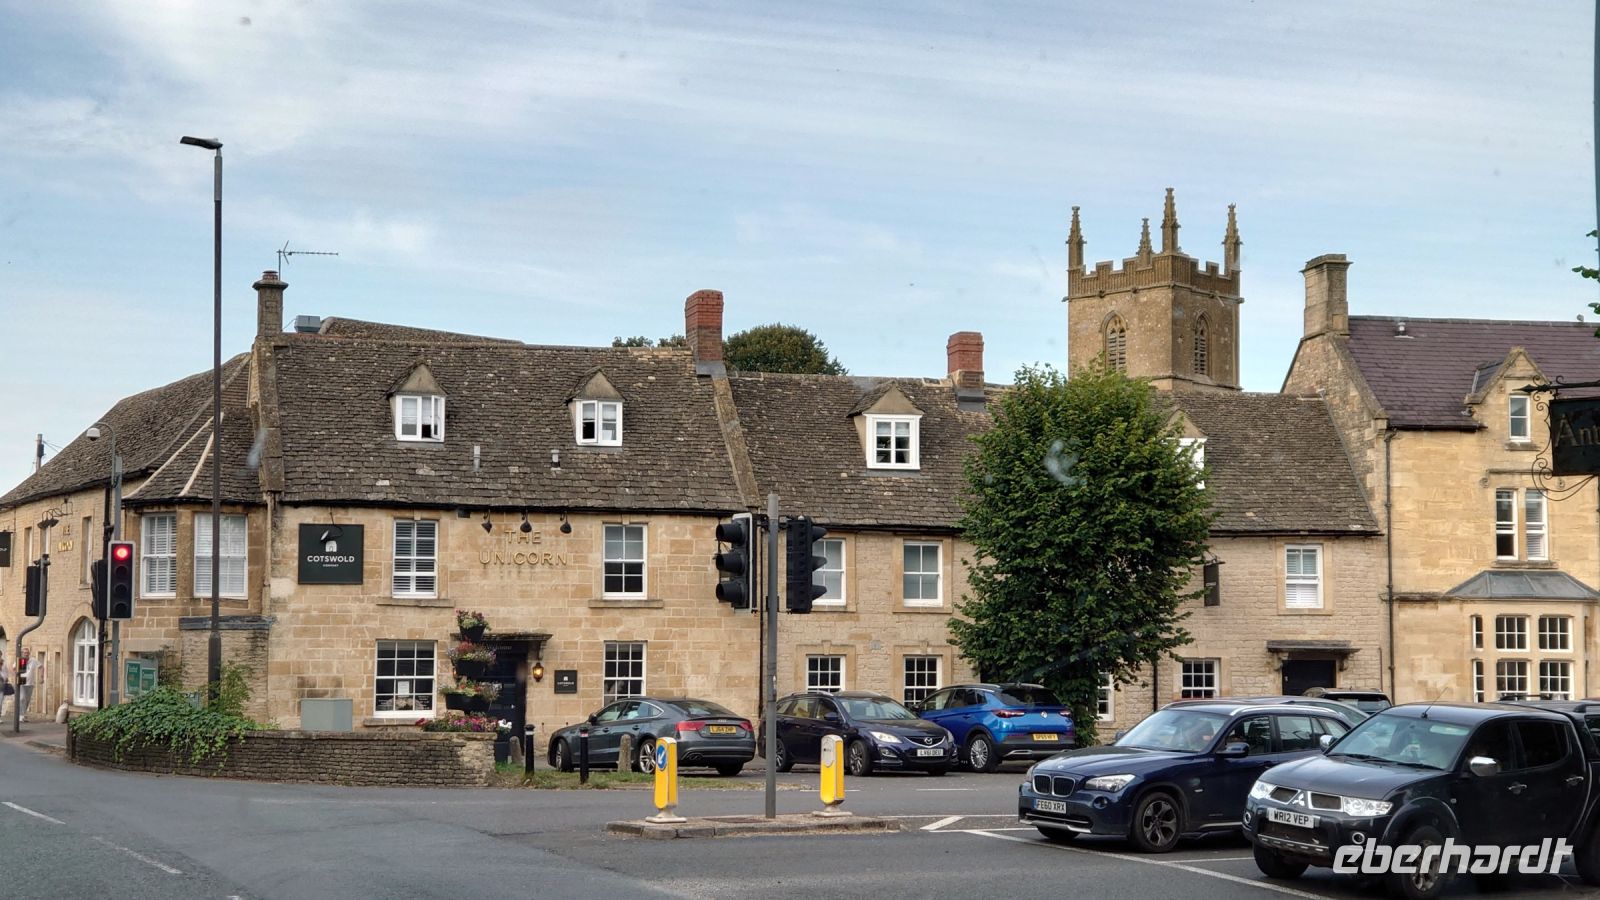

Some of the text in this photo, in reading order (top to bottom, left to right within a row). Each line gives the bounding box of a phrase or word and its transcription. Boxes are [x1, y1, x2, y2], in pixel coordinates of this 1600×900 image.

[504, 529, 542, 544] THE
[306, 555, 355, 563] COTSWOLD
[479, 551, 568, 566] UNICORN
[1037, 800, 1065, 811] FE60 XRX
[1273, 810, 1310, 826] WR12 VEP
